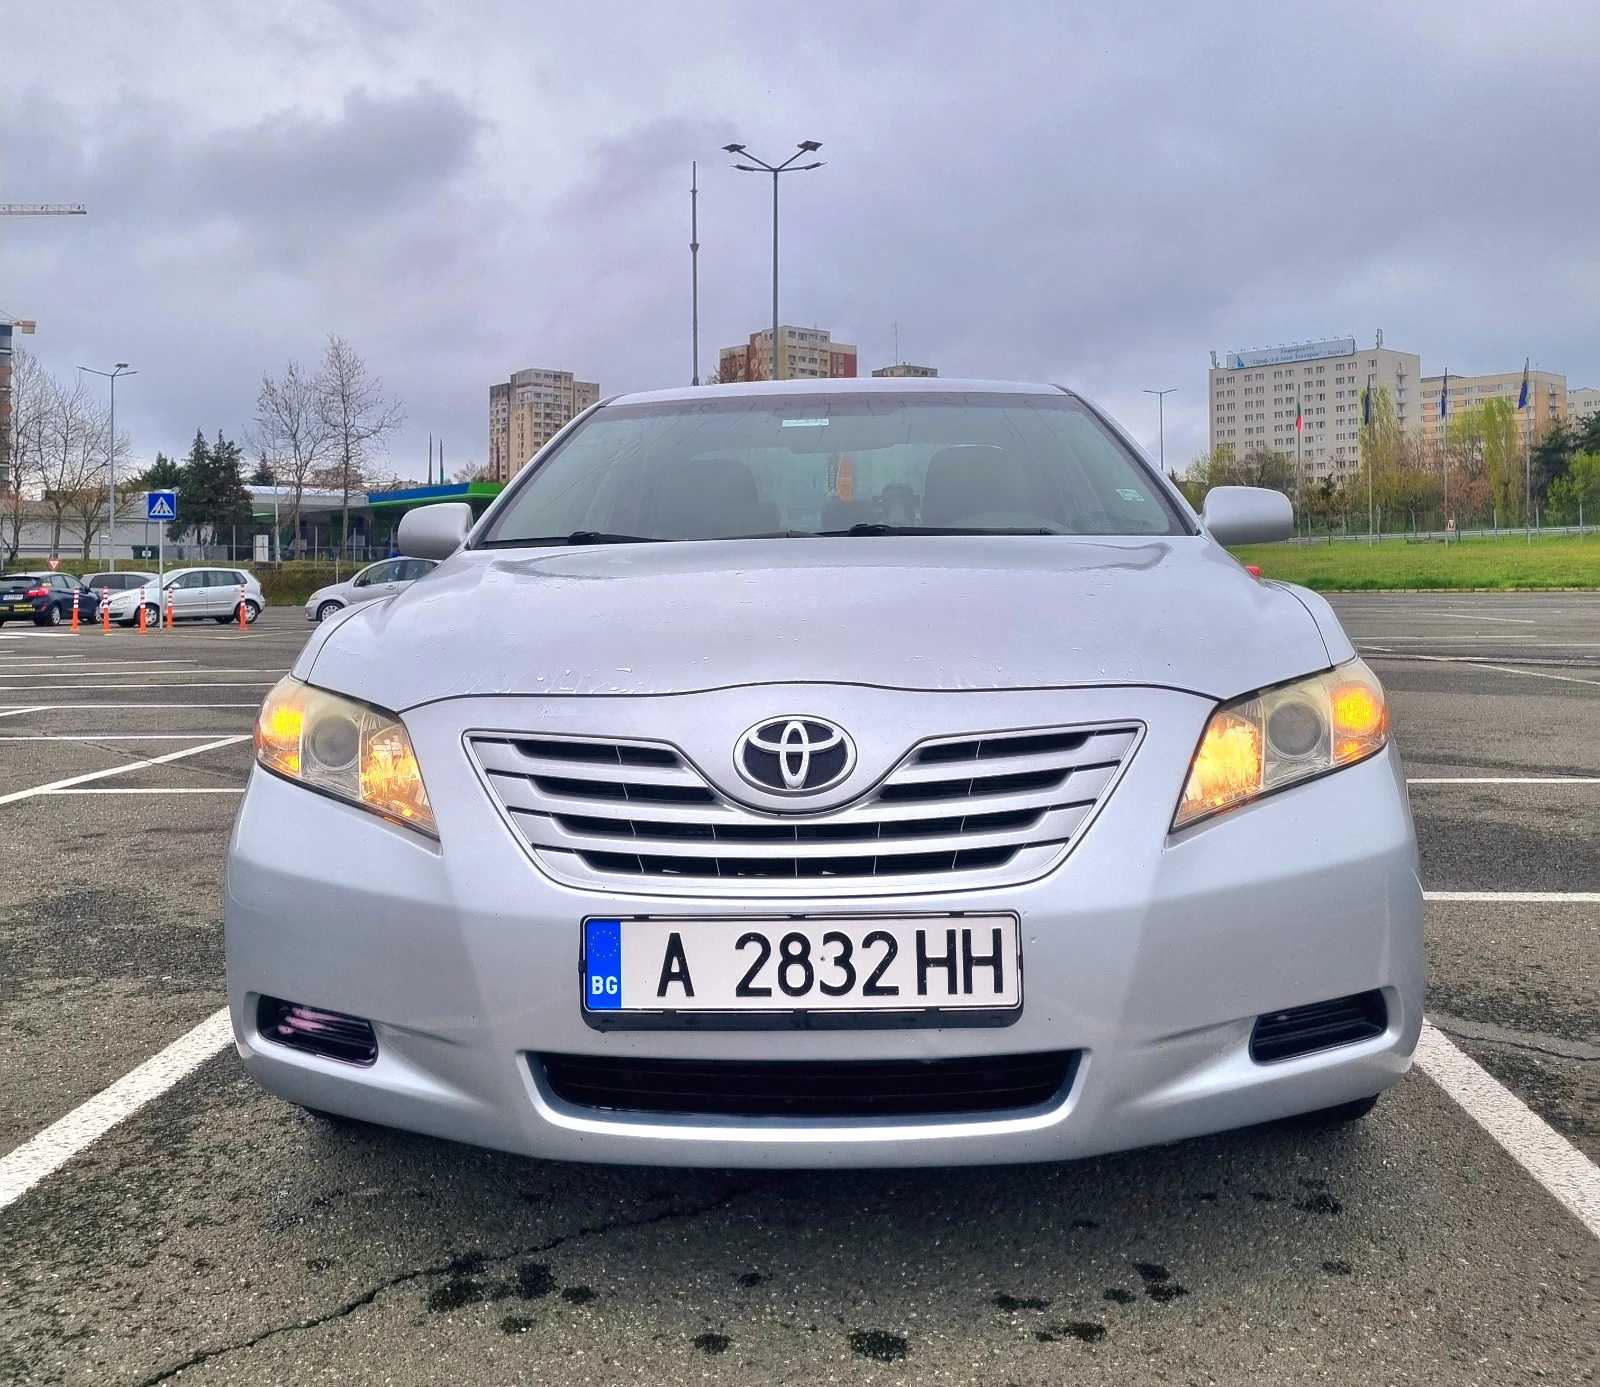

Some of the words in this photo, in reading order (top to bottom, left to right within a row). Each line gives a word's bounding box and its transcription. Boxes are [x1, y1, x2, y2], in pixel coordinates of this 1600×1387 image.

[591, 975, 618, 995] BG
[657, 931, 696, 998] A
[734, 930, 900, 998] 2832
[915, 927, 1004, 996] HH
